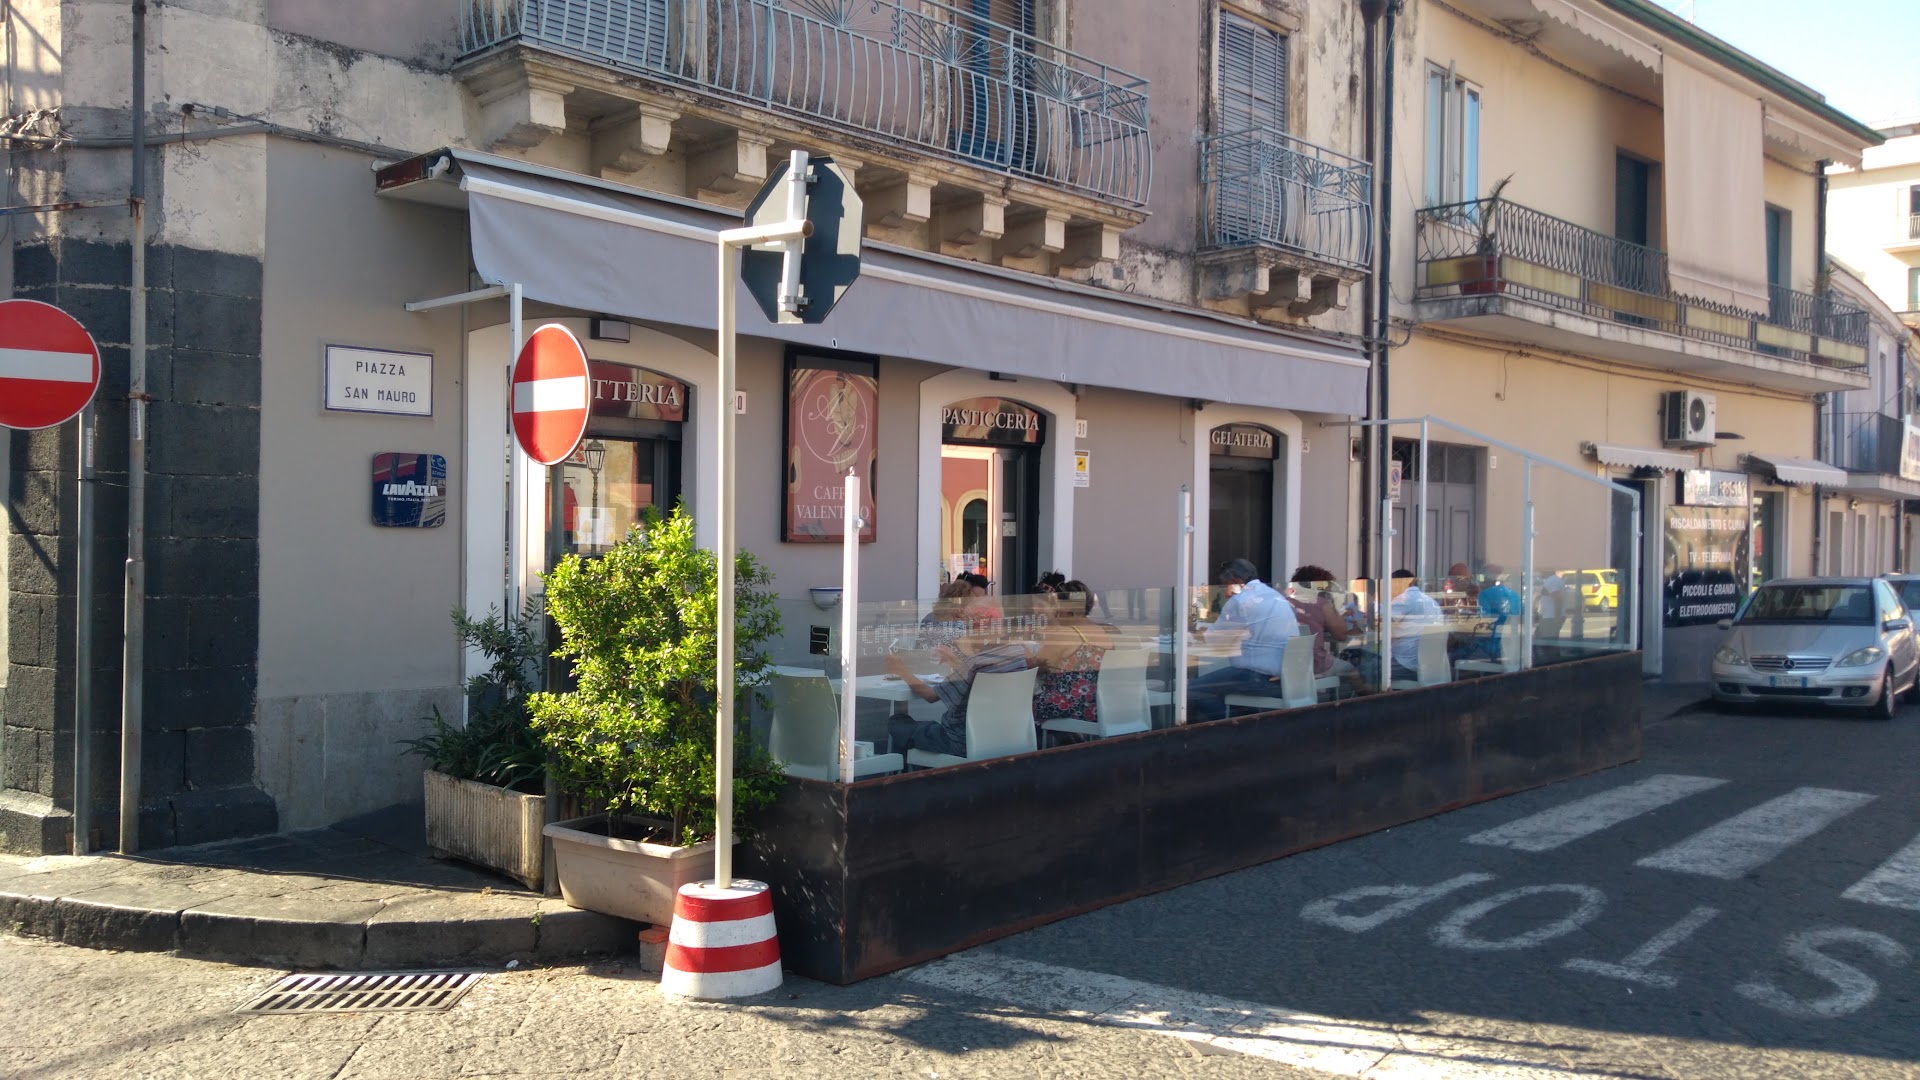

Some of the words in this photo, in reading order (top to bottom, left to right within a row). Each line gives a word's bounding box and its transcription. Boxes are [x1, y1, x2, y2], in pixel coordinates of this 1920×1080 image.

[356, 361, 406, 376] PIAZZA
[344, 386, 369, 400] SAN
[377, 389, 416, 403] MAURO
[592, 378, 680, 407] TTERIA
[941, 406, 1040, 431] PASTICCERIA
[1077, 422, 1086, 436] 31
[1211, 429, 1273, 449] GELATERIA
[382, 480, 439, 497] LAVAZZA
[814, 485, 845, 500] CAFF
[796, 504, 870, 520] VALENTO
[1670, 517, 1722, 530] RISCALDAMENTO
[1723, 519, 1728, 530] E
[1689, 551, 1697, 563] TV
[1682, 584, 1708, 597] PICCOLI
[1708, 584, 1713, 596] E
[1713, 583, 1736, 595] GRANDI
[1679, 602, 1737, 617] ELETTRODOMESTICI
[1300, 872, 1912, 1018] STOP
